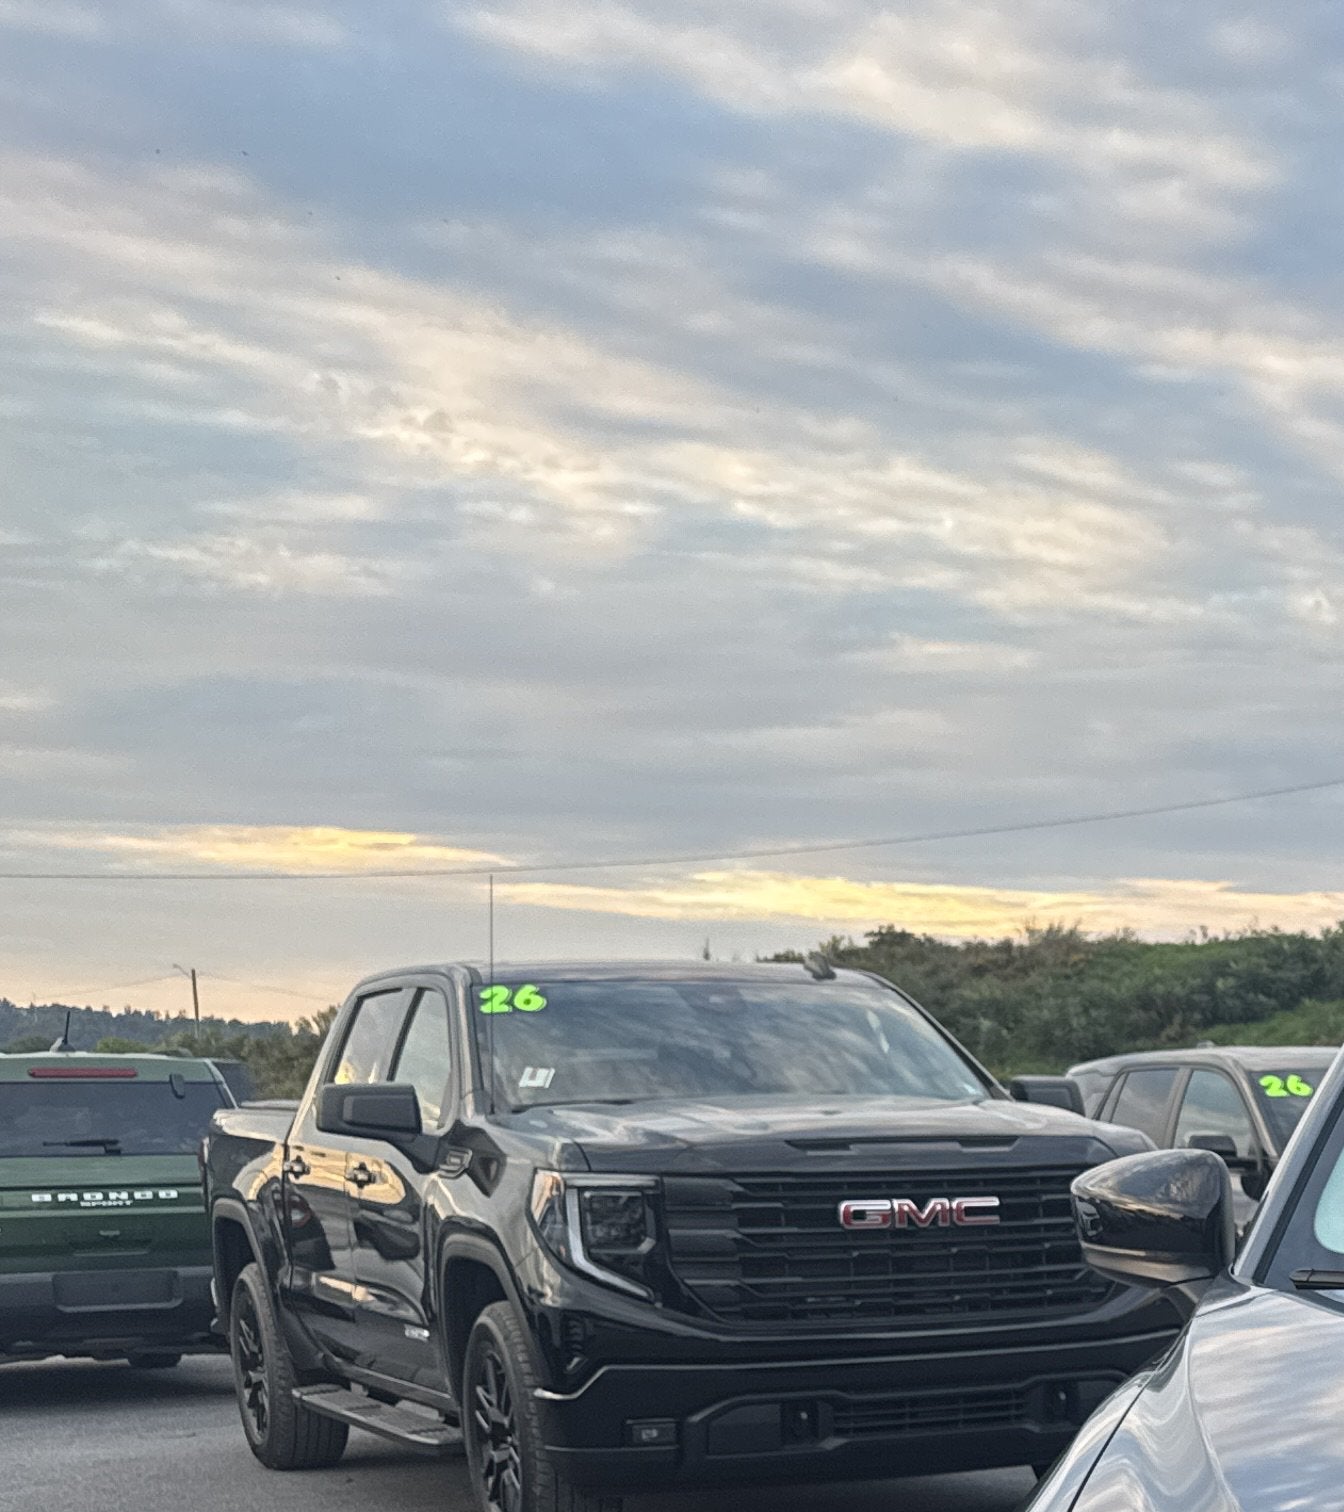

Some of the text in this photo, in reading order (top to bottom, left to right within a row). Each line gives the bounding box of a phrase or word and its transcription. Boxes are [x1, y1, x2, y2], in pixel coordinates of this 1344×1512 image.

[479, 983, 548, 1014] 26
[1258, 1074, 1314, 1098] 26
[838, 1195, 1001, 1230] GMC
